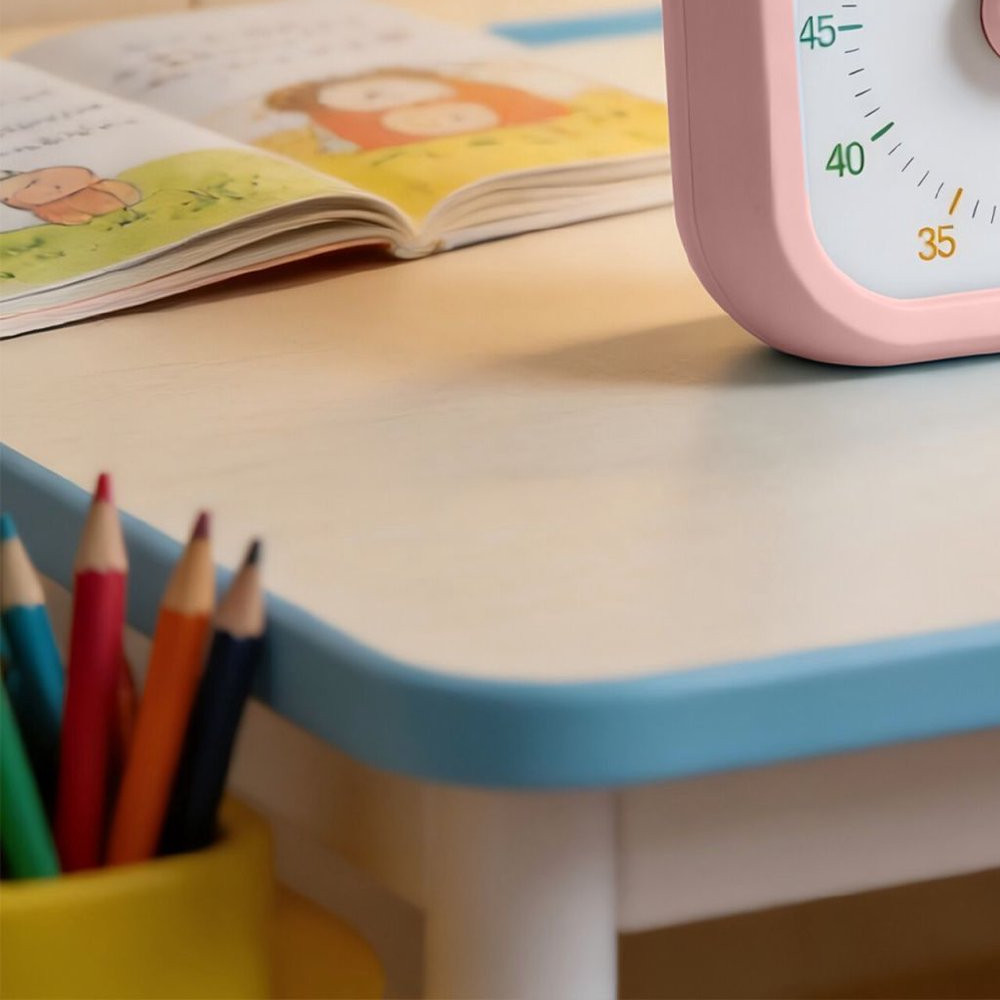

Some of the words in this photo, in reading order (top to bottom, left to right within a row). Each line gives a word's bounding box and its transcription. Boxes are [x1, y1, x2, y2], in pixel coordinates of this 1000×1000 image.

[799, 15, 836, 49] 45
[826, 142, 865, 178] 40
[919, 225, 957, 261] 35
